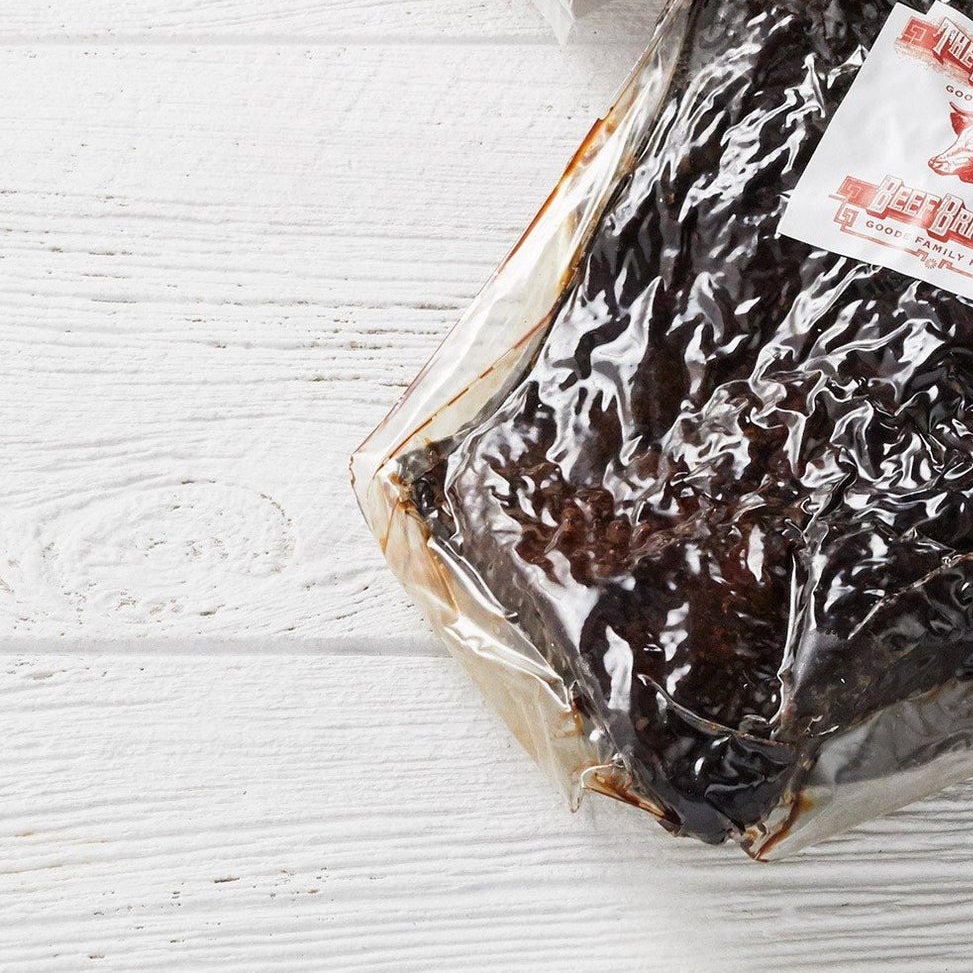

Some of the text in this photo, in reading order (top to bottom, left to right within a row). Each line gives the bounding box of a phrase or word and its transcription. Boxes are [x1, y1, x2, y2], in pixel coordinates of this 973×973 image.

[869, 174, 942, 218] BEEF
[866, 220, 910, 240] GOOD
[915, 236, 965, 261] FAMILY
